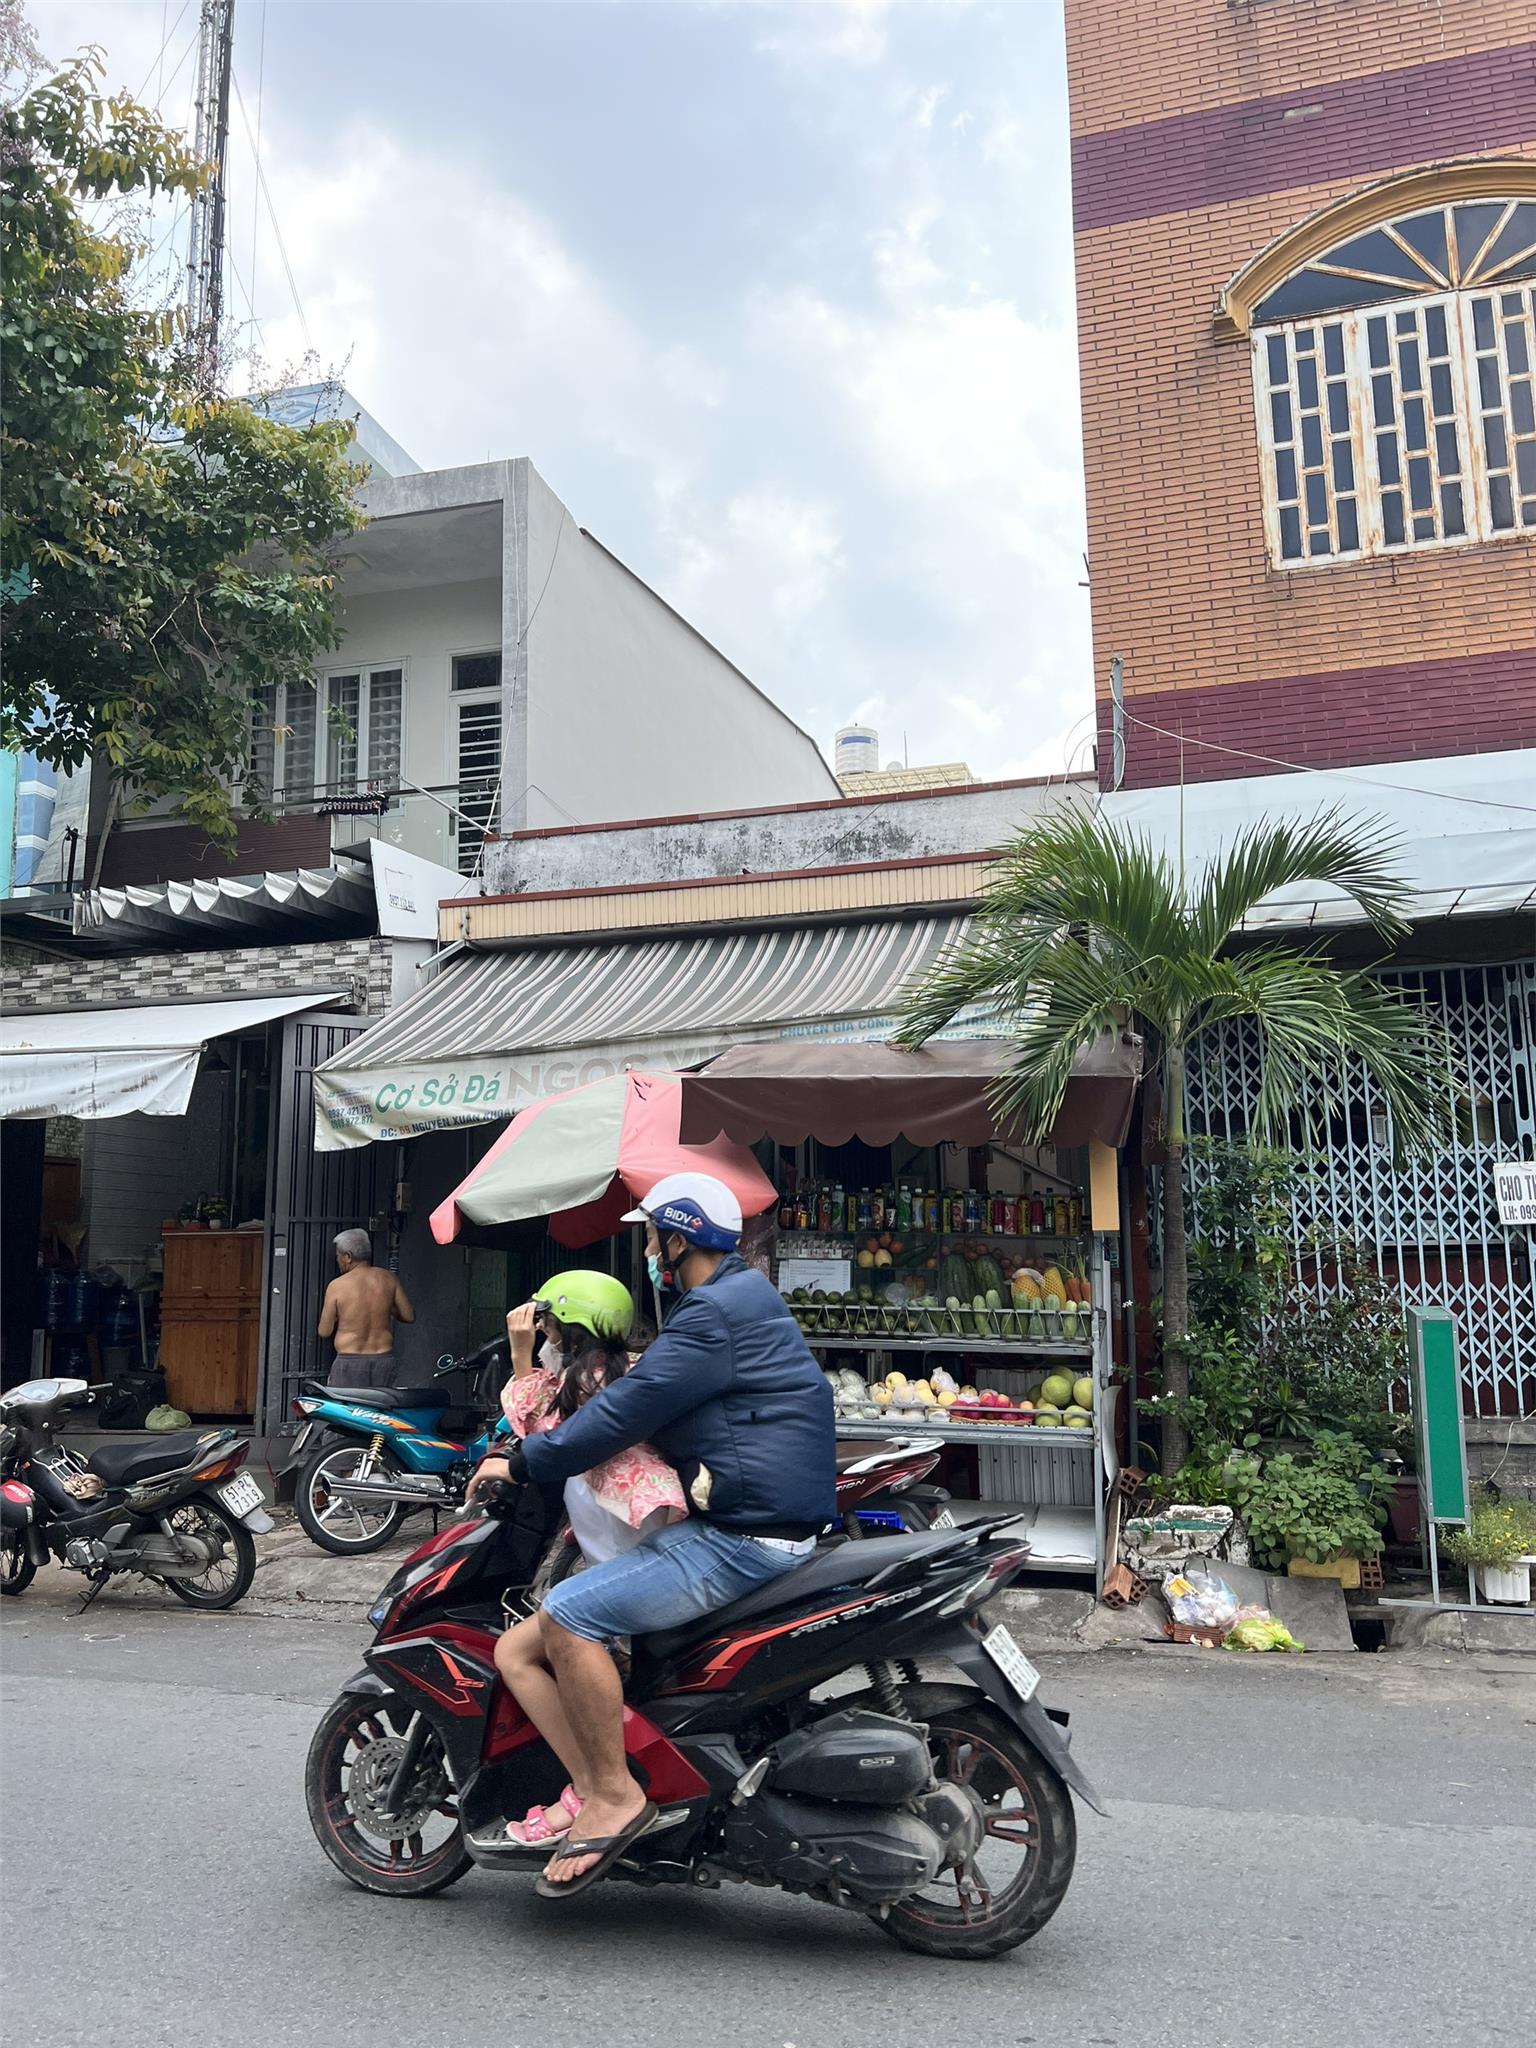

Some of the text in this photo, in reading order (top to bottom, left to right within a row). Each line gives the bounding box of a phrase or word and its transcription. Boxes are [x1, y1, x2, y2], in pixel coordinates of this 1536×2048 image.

[833, 1021, 855, 1033] GIA
[375, 1083, 416, 1113] Cơ
[418, 1073, 459, 1107] Sở
[462, 1071, 502, 1104] Đá
[1499, 1175, 1523, 1202] CHO
[664, 1206, 693, 1224] BIDV
[1503, 1205, 1519, 1220] LH:
[234, 1489, 260, 1512] 7319
